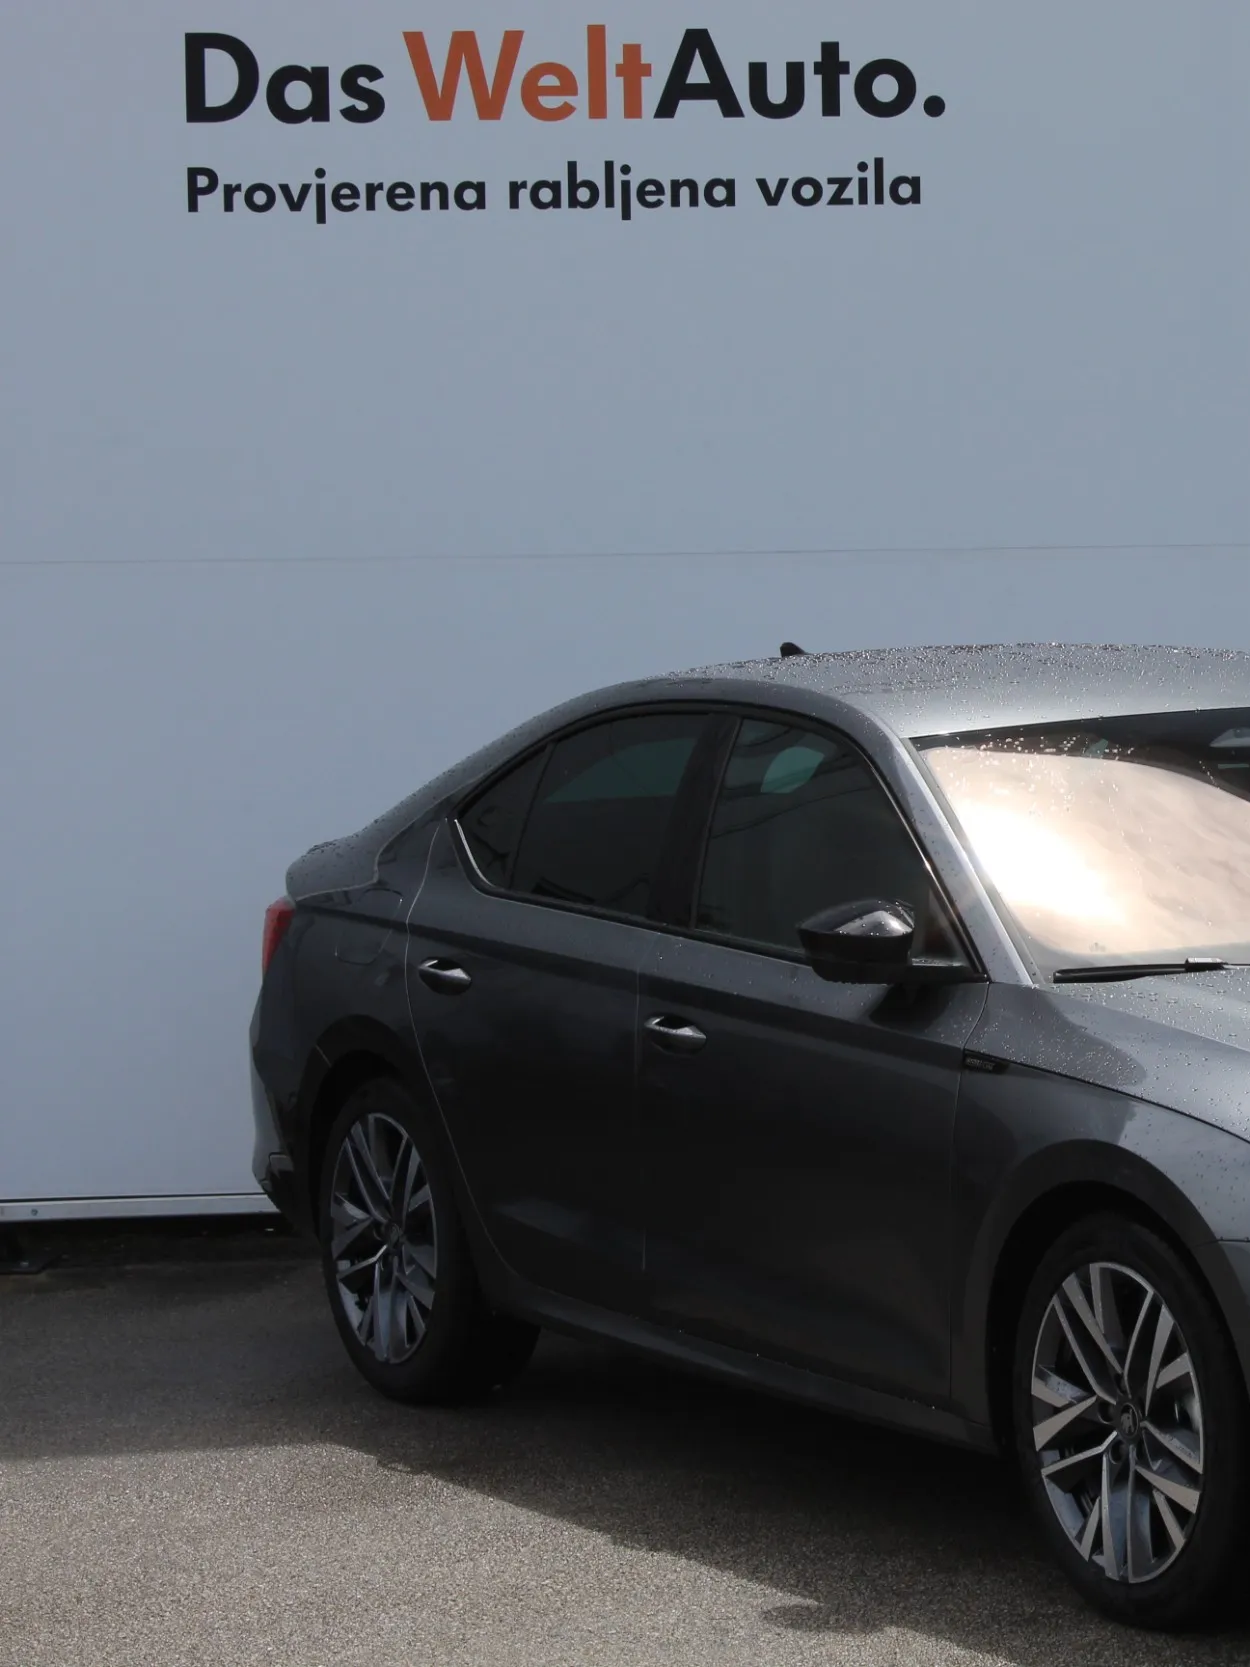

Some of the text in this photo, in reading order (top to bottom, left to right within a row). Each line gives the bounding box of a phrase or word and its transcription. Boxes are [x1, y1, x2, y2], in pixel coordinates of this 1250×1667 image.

[184, 24, 946, 125] Das WeltAuto.
[186, 156, 921, 225] Provjerena rabljena vozila
